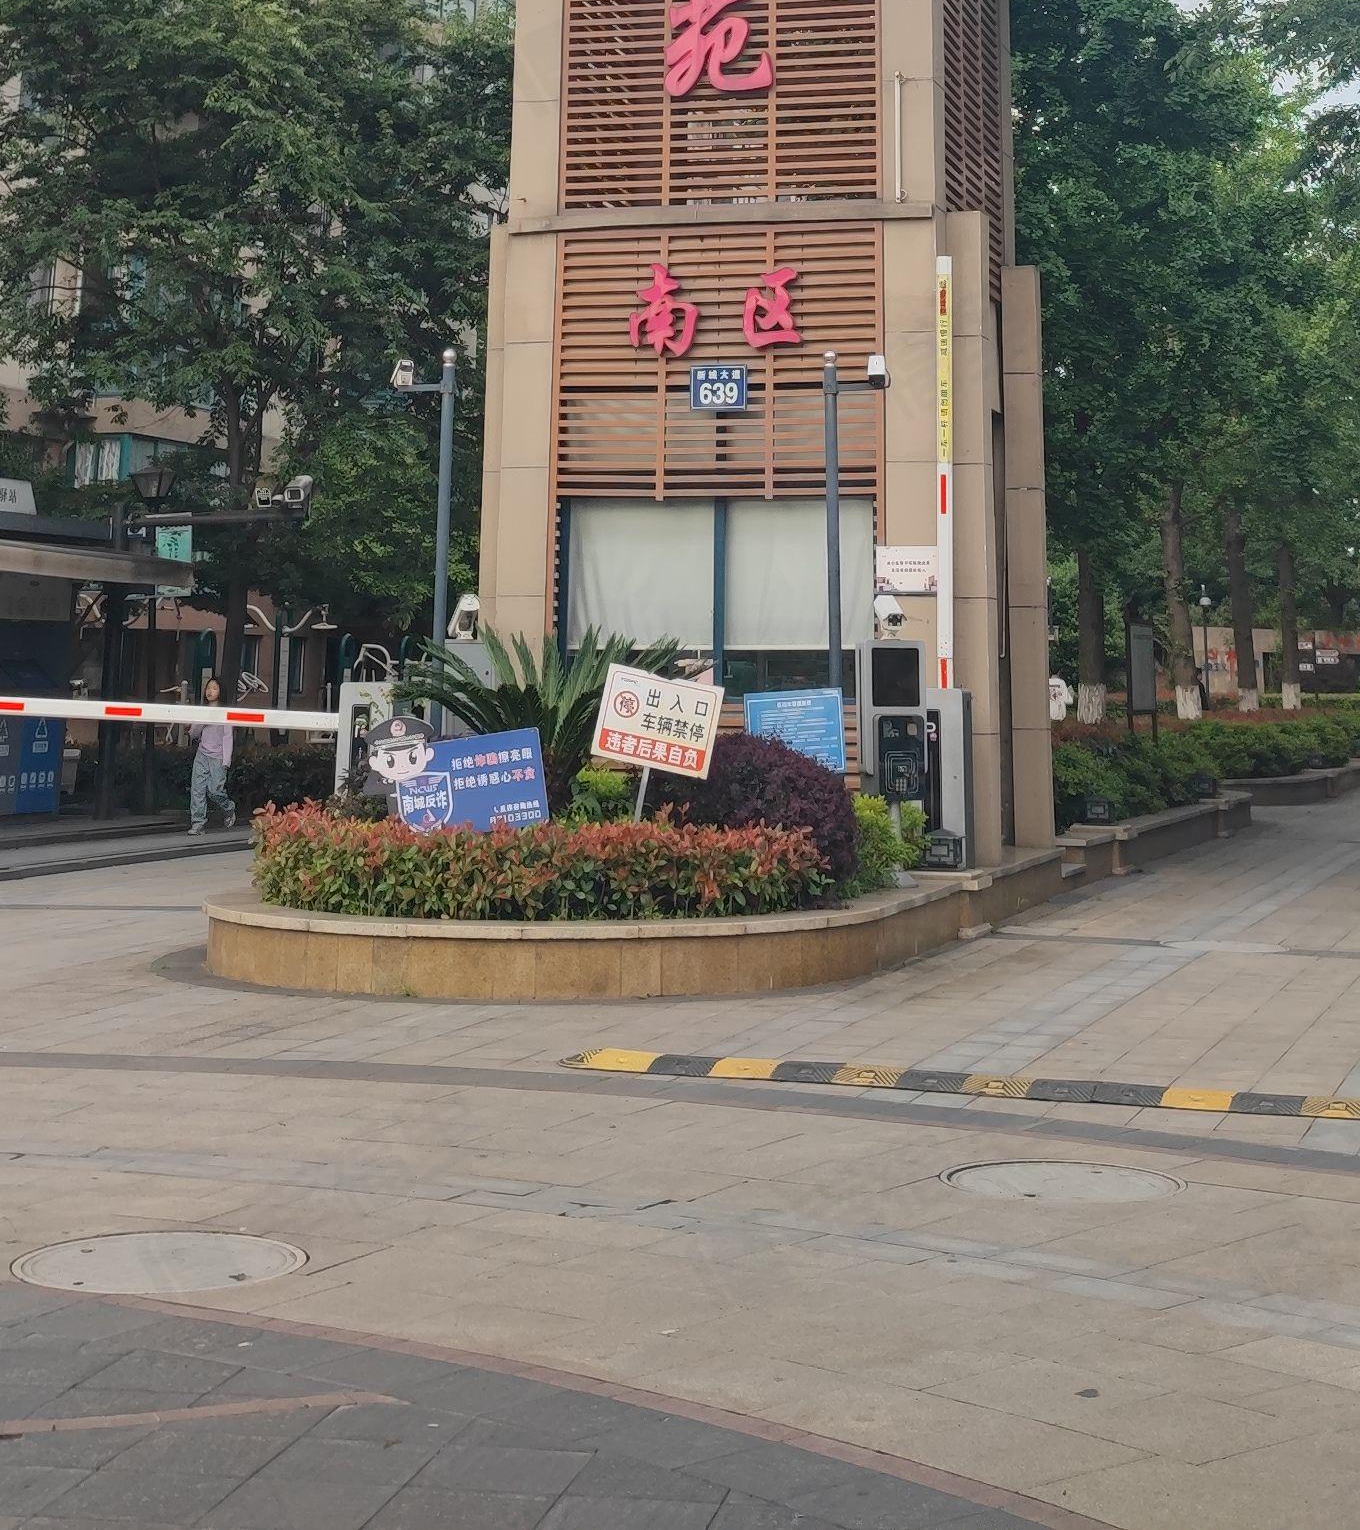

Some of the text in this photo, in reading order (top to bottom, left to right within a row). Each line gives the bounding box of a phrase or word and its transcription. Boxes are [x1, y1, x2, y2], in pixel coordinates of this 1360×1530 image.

[629, 263, 802, 357] 南区
[696, 369, 741, 381] 新城大道
[699, 382, 738, 405] 639
[646, 688, 709, 716] 出入口
[640, 712, 705, 742] 车辆禁停
[450, 747, 533, 771] 拒绝诈骗擦亮眼
[605, 731, 698, 768] 违者后果自负
[453, 766, 535, 791] 拒绝诱惑心不贪
[401, 789, 448, 815] 南城反诈
